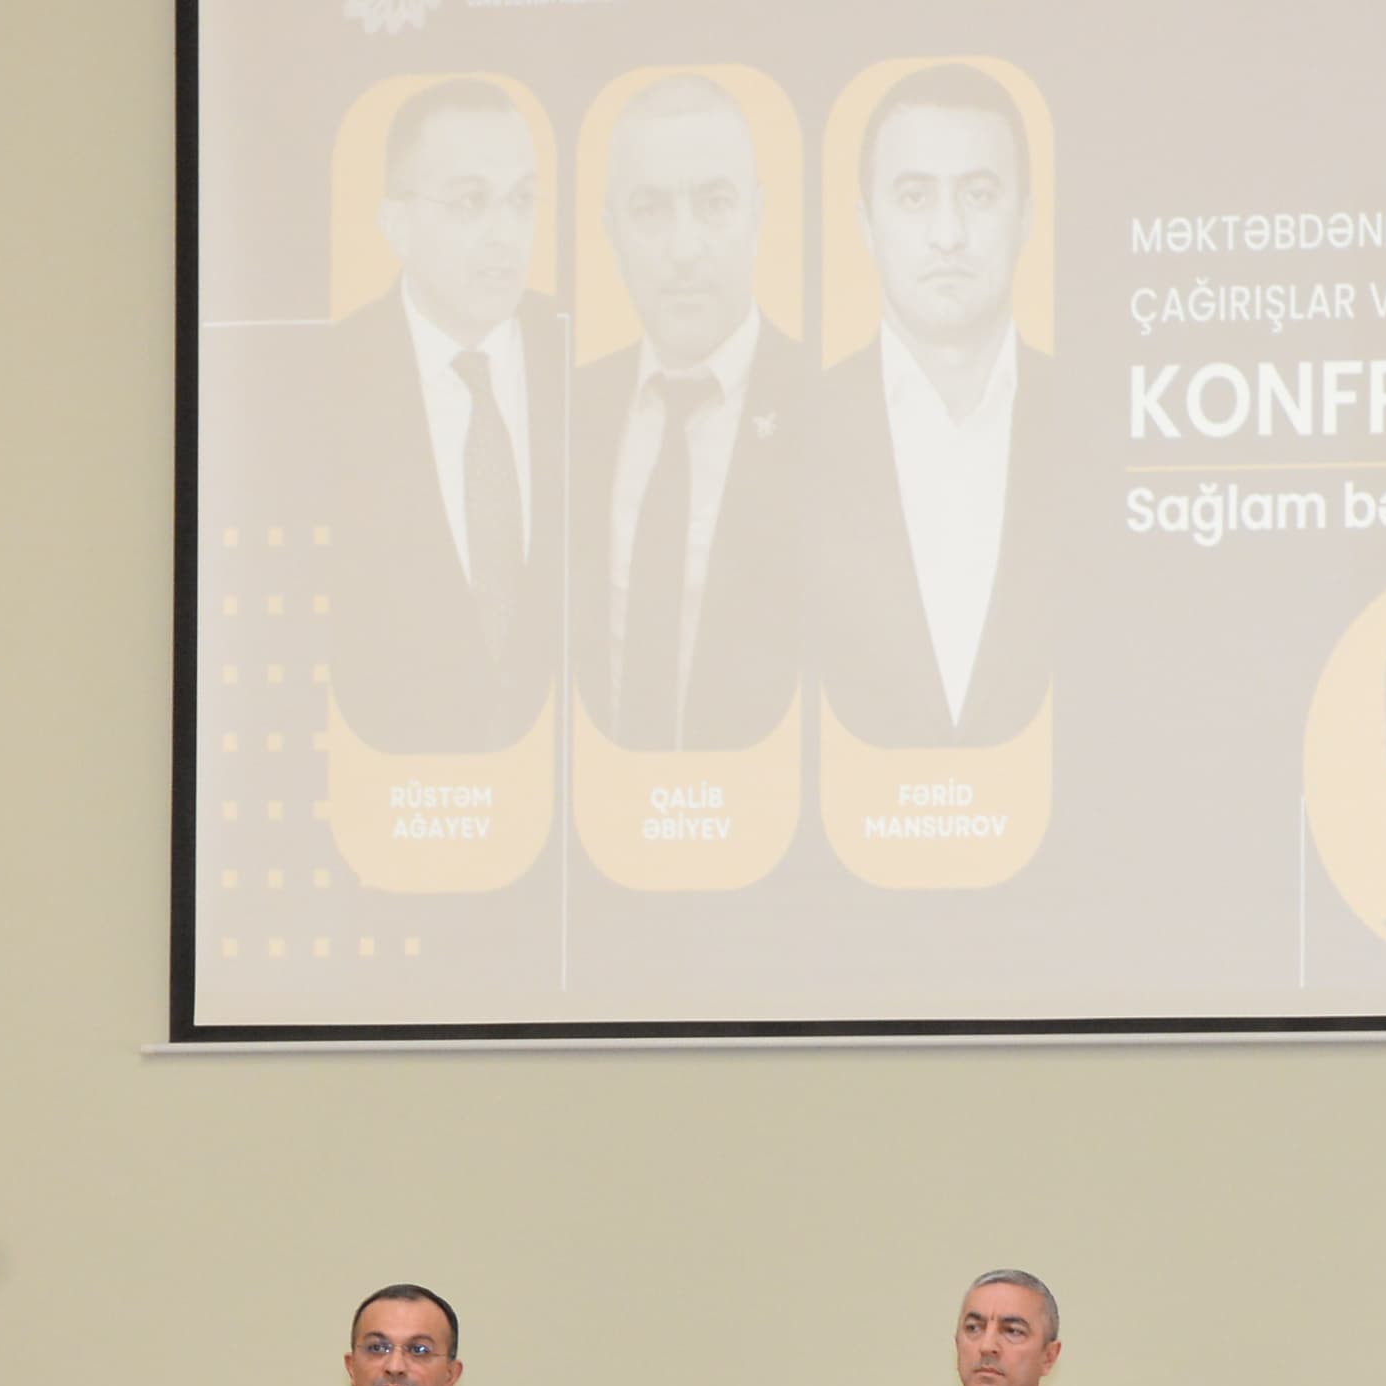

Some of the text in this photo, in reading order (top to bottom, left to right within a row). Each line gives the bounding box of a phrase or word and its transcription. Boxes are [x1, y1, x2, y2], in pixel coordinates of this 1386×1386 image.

[1130, 276, 1355, 336] ÇAĞIRIŞLAR
[1127, 482, 1326, 546] Sağlam
[651, 781, 724, 811] QALİB
[899, 777, 973, 807] FƏRİD
[393, 811, 491, 839] AĞAYEV
[642, 811, 732, 840] ƏBİYEV
[865, 814, 1007, 838] MANSUROV
